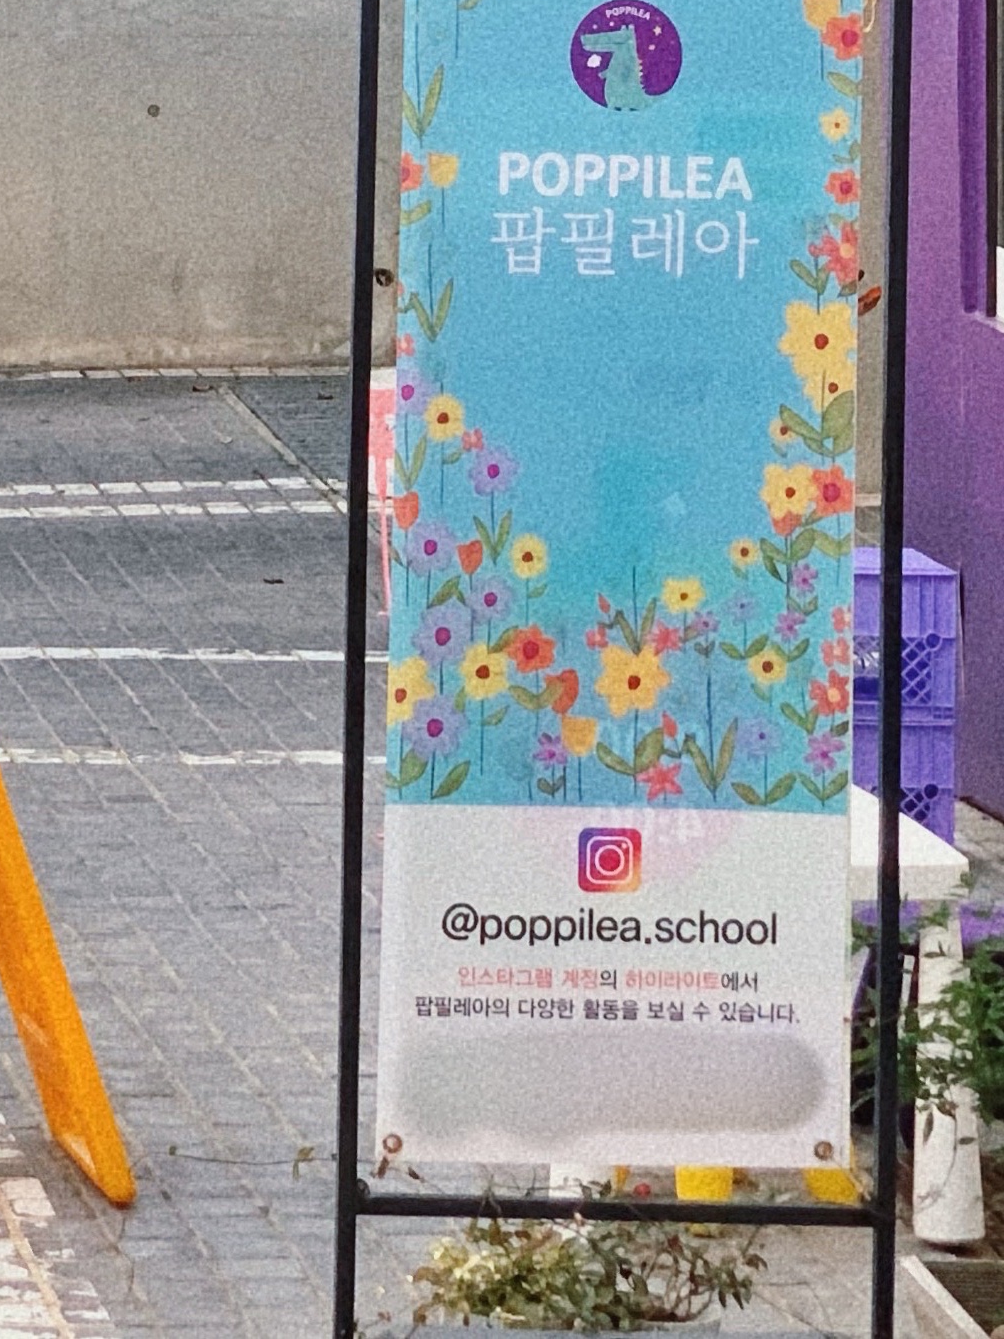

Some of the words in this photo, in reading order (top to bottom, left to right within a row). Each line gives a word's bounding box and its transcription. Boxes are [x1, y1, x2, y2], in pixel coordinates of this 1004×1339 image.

[605, 5, 651, 20] POPPILEA
[499, 152, 753, 201] POPPILEA
[490, 206, 760, 279] 팝필레아
[441, 902, 778, 947] @poppilea.school
[457, 965, 553, 989] 인스타그램
[561, 967, 618, 990] 계정의
[625, 968, 759, 993] 하이라이트에서
[415, 995, 510, 1018] 팝필레아의
[518, 997, 575, 1020] 다양한
[583, 998, 639, 1021] 활동을
[647, 1000, 685, 1021] 보실
[692, 1001, 711, 1022] 수
[719, 1001, 801, 1024] 있습니다.
